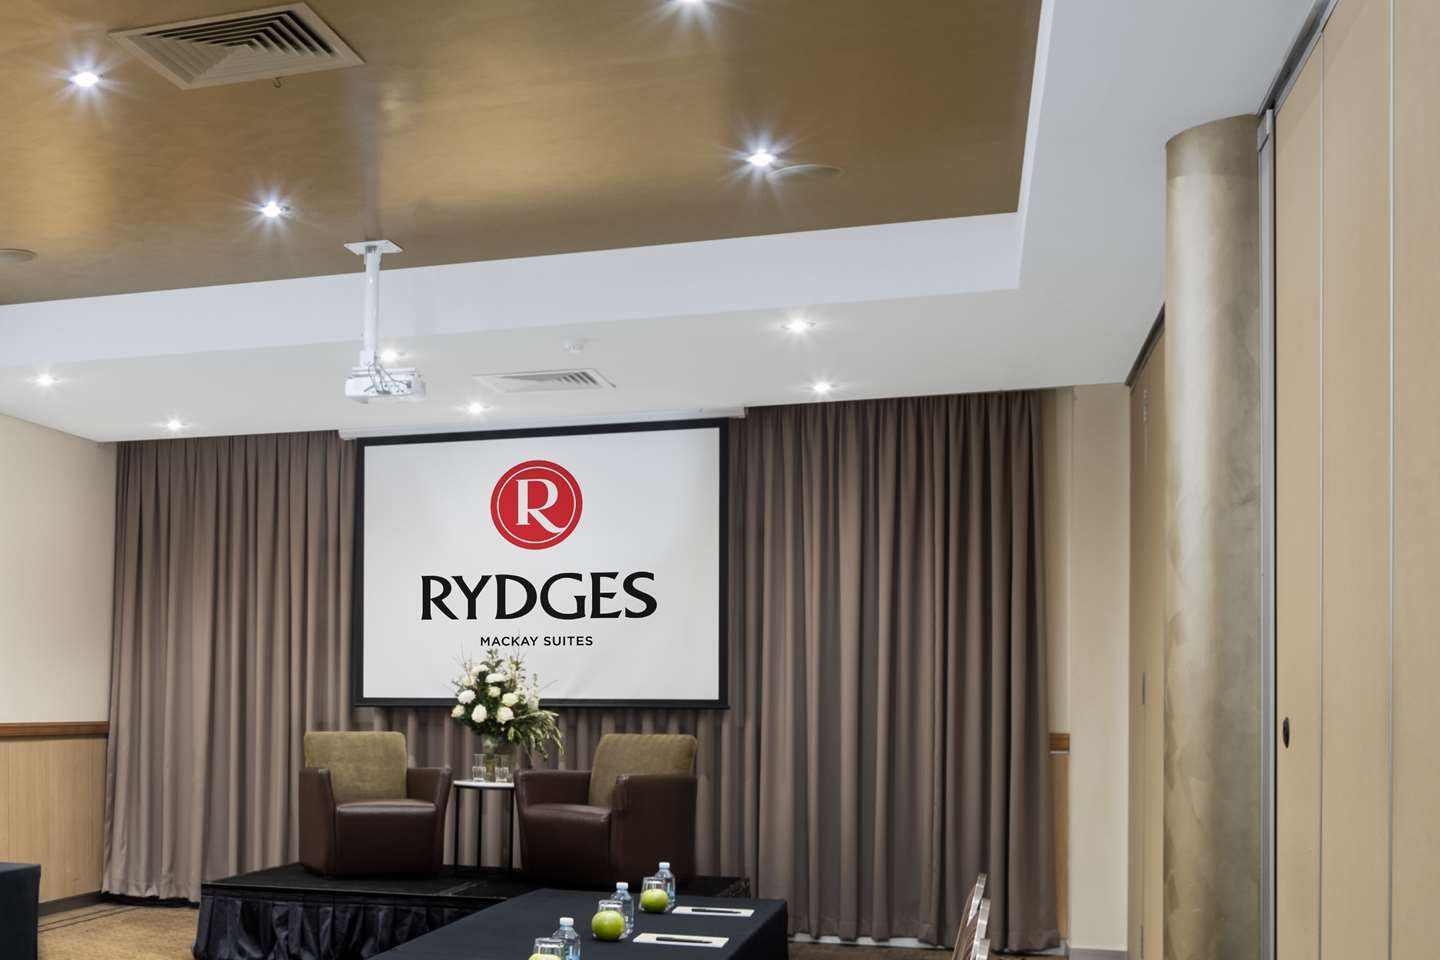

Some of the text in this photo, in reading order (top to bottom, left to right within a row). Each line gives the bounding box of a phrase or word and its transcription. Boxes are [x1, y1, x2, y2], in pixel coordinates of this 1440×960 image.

[516, 478, 566, 534] R
[421, 571, 658, 620] RYDGES
[480, 635, 593, 647] MACKAY SUITES
